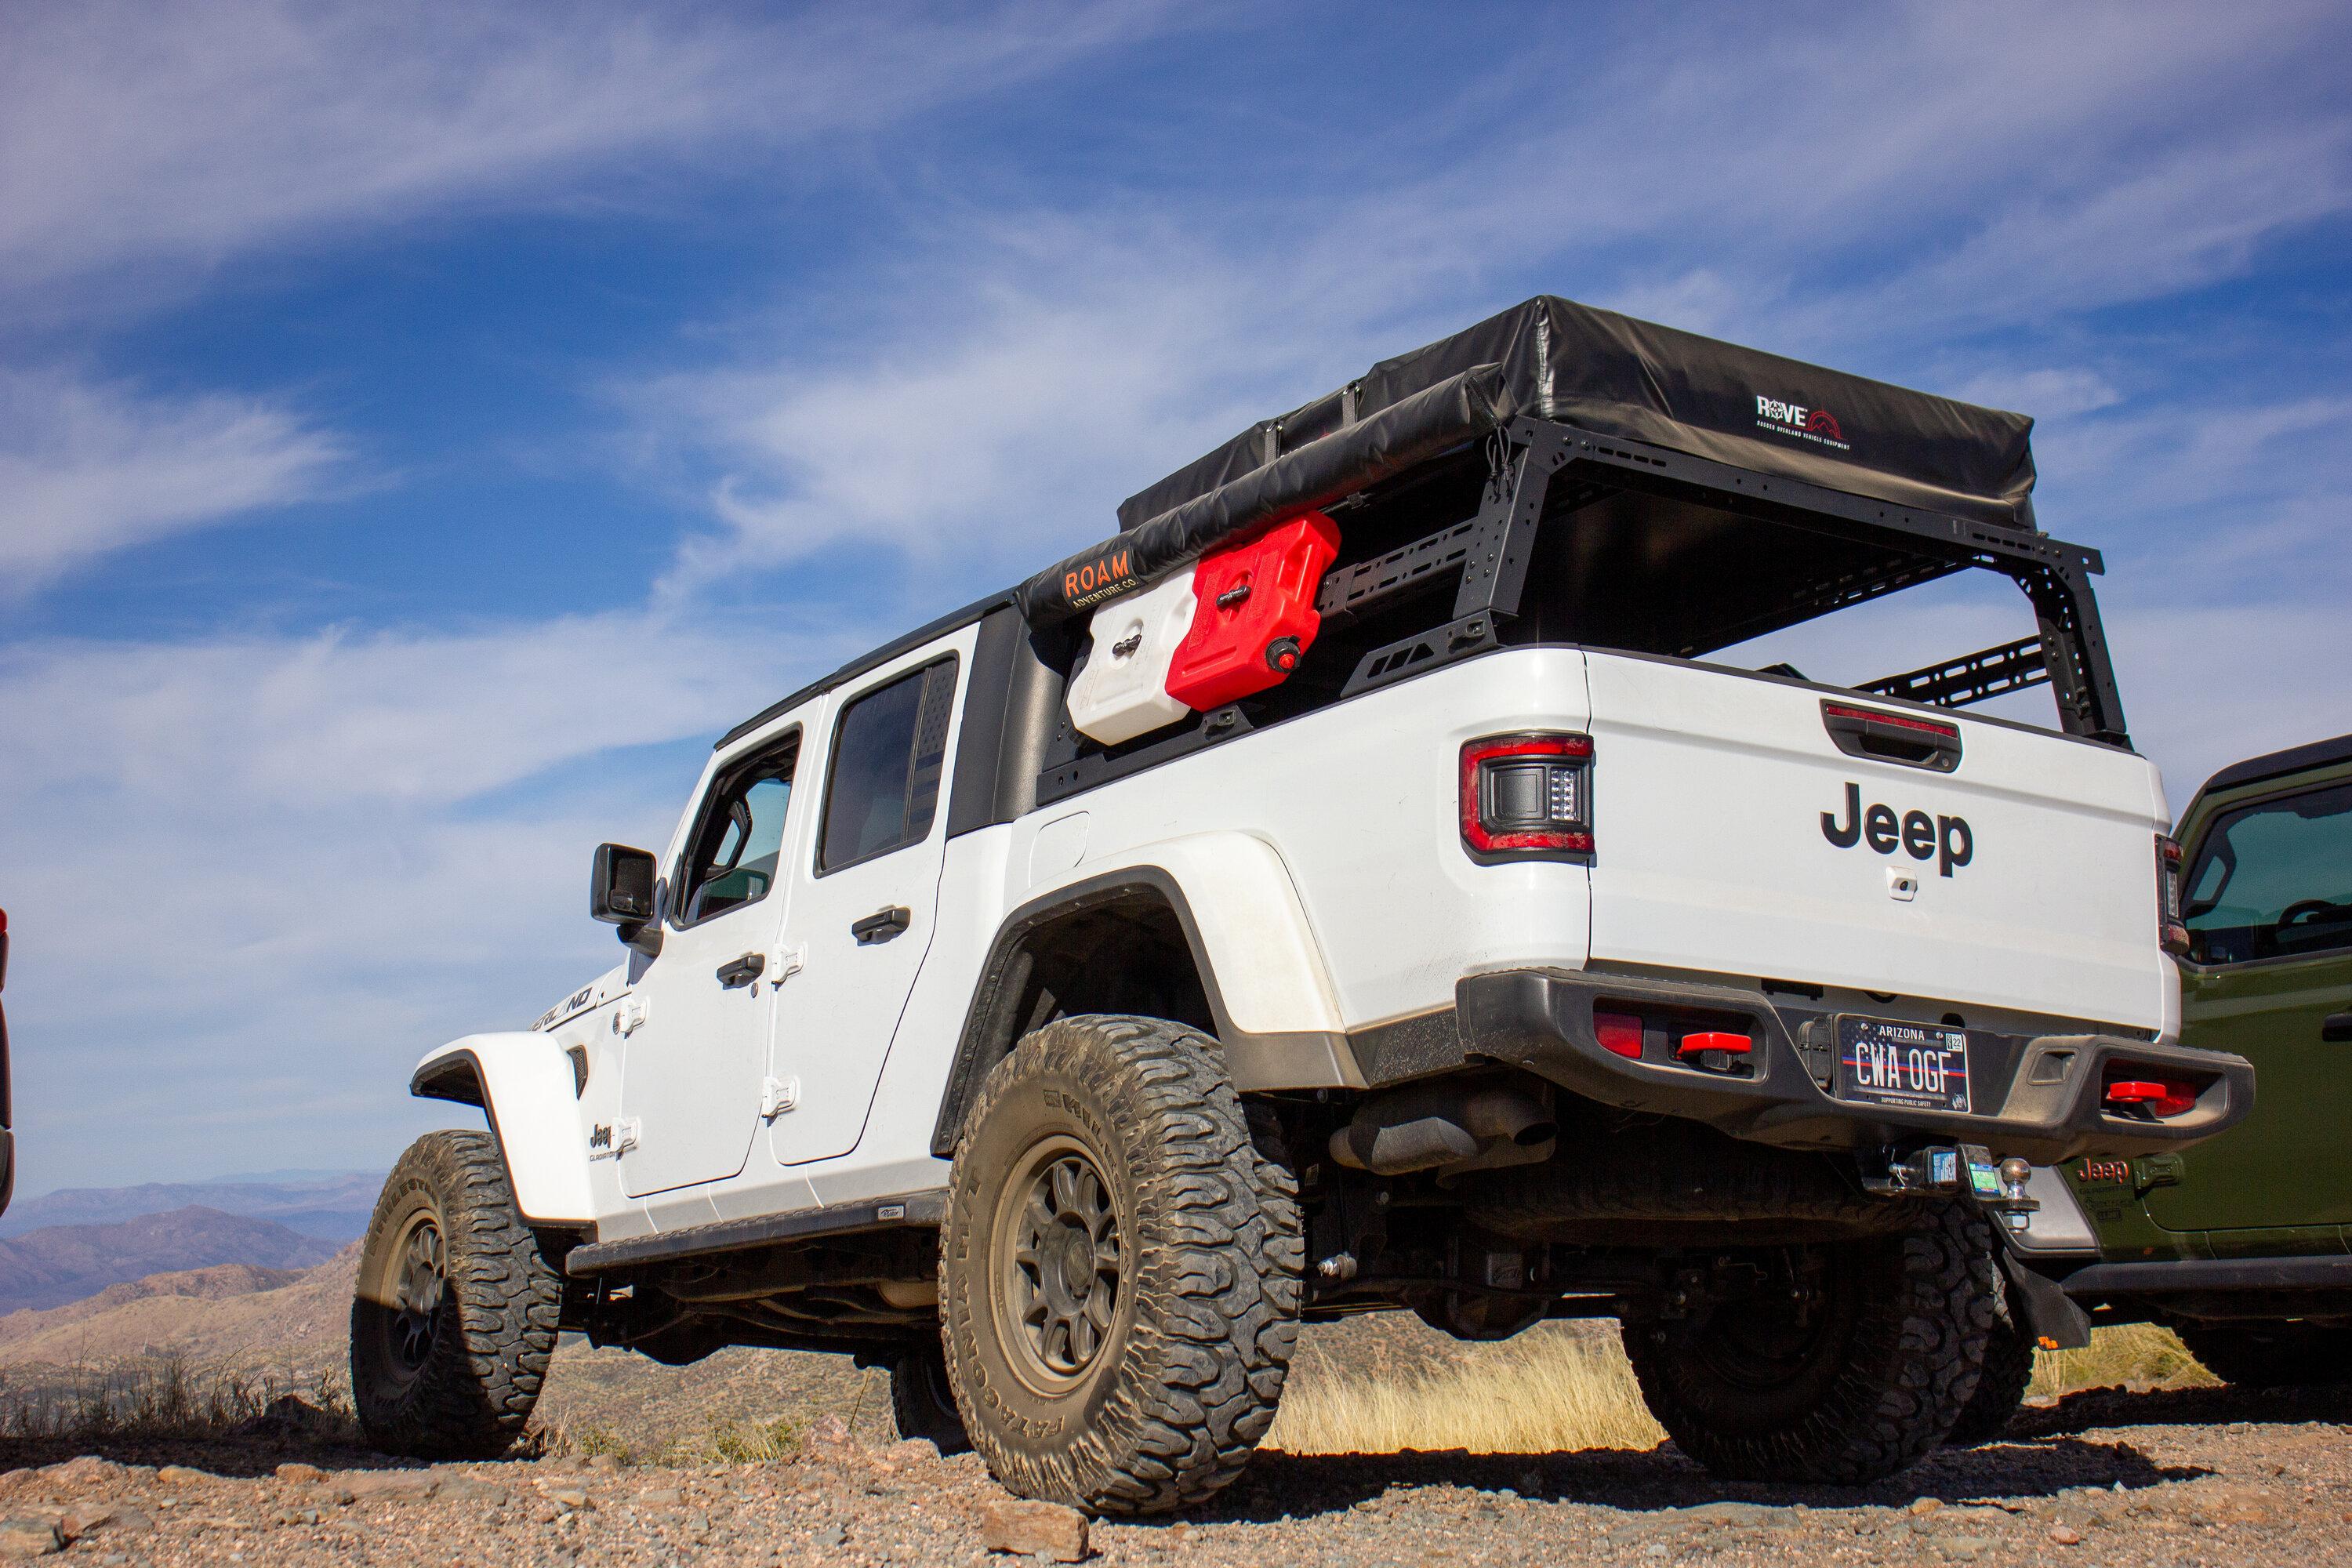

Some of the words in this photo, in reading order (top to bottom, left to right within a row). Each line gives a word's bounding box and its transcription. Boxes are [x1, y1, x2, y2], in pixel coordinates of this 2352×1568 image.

[1756, 395, 1807, 426] ROVE
[1777, 426, 1802, 437] OVERLAND
[1803, 433, 1822, 443] VEHICLE
[1824, 438, 1849, 450] EQUIPMENT
[1065, 550, 1129, 598] ROAM
[1073, 583, 1123, 608] ADVENTURE
[1122, 579, 1139, 588] CO.
[1820, 782, 1973, 878] Jeep
[1879, 1025, 1925, 1041] ARIZONA
[1953, 1037, 1962, 1047] 22
[1855, 1042, 1901, 1089] CWA
[2078, 1158, 2129, 1184] Jeep
